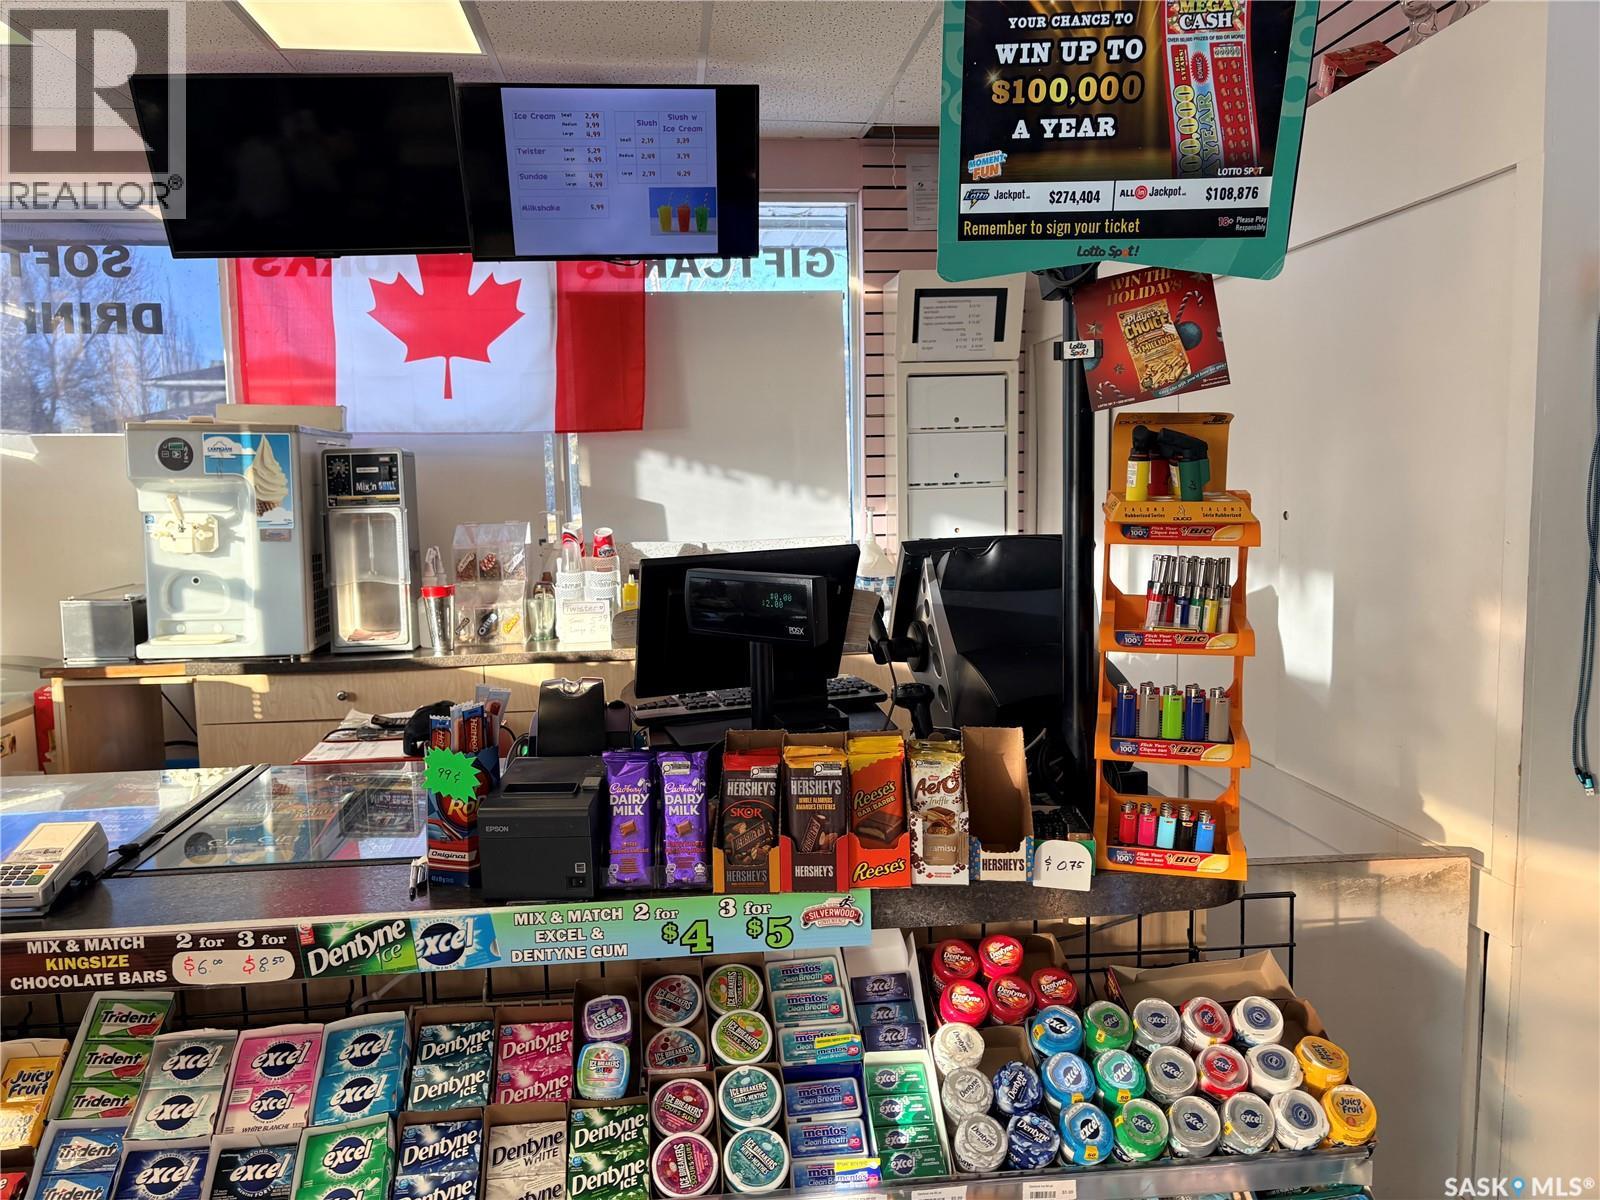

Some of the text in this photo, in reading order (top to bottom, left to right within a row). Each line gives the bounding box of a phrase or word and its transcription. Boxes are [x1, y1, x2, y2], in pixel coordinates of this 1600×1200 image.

[1180, 0, 1233, 12] MEGA
[1008, 12, 1134, 29] YOUR CHANCE TO
[1179, 12, 1233, 29] CASH
[995, 38, 1143, 64] WIN UP TO
[991, 75, 1144, 105] $100,000
[530, 112, 556, 120] Cream
[636, 119, 658, 127] Slush
[667, 113, 688, 121] Slush
[1012, 117, 1116, 140] A YEAR
[517, 147, 546, 155] Twister
[968, 153, 1005, 168] MOMENT
[972, 165, 1001, 180] FUN
[1218, 168, 1242, 176] LOTTO
[994, 188, 1025, 201] Jackpot
[1049, 189, 1101, 206] $274,404
[1119, 186, 1259, 202] ALL Jackpot $108,876
[1236, 216, 1254, 224] Please
[1255, 215, 1267, 224] Play
[964, 218, 1140, 237] Remember to sign your ticket
[1235, 223, 1266, 232] Responsibly
[1077, 245, 1140, 259] Lotto Spot!
[1124, 315, 1171, 340] CHOICE
[1069, 342, 1087, 351] Lotto
[609, 782, 642, 795] Cadbury
[664, 782, 697, 795] Cadbury
[727, 781, 776, 796] HERSHEY'S
[791, 780, 841, 796] HERSHEY'S
[914, 773, 961, 799] Aero
[609, 793, 649, 806] DAIRY
[665, 793, 704, 806] DAIRY
[853, 780, 896, 810] Reese's
[612, 805, 645, 817] MILK
[668, 805, 701, 817] MILK
[730, 807, 763, 819] SKOR
[485, 825, 509, 833] EPSON
[431, 850, 467, 860] Original
[726, 869, 768, 883] HERSHEY'S
[794, 865, 833, 878] HERSHEY'S
[852, 858, 906, 883] Reese's
[633, 902, 679, 921] 2 for
[719, 897, 772, 918] 3 for
[808, 908, 855, 920] SILVERWOOD
[513, 907, 624, 926] MIX & MATCH
[416, 916, 475, 960] excel
[534, 927, 604, 943] EXCEL &
[661, 918, 714, 954] $4
[746, 915, 794, 949] $5
[26, 936, 145, 955] MIX & MATCH
[175, 931, 287, 949] 2 for 3 for
[307, 919, 406, 978] Dentyne
[511, 943, 628, 963] DENTYNE GUM
[988, 943, 1014, 960] Dentyne
[45, 955, 129, 971] KINGSIZE
[781, 964, 822, 976] mentos
[10, 970, 167, 990] CHOCOLATE BARS
[799, 972, 823, 982] Breath
[787, 994, 828, 1004] mentos
[805, 1002, 829, 1012] Breath
[101, 1009, 158, 1024] Trident
[593, 1012, 607, 1024] ICE
[594, 1012, 624, 1030] CUBES
[421, 1028, 490, 1061] Dentyne
[466, 1043, 484, 1056] ICE
[665, 1044, 695, 1058] BREAKERS
[161, 1044, 224, 1073] excel
[251, 1040, 312, 1070] excel
[597, 1060, 620, 1068] BREAKERS
[10, 1069, 54, 1085] Juicy
[8, 1082, 49, 1099] Fruit
[412, 1069, 485, 1104] Dentyne
[459, 1085, 478, 1098] ICE
[500, 1074, 569, 1104] Dentyne
[797, 1085, 841, 1097] mentos
[545, 1090, 562, 1101] ICE
[817, 1094, 842, 1104] Breath
[1338, 1097, 1361, 1108] Juicy
[146, 1094, 208, 1122] excel
[249, 1093, 295, 1115] excel
[1240, 1110, 1263, 1124] excel
[262, 1124, 290, 1132] BLANCHE
[1017, 1120, 1051, 1143] Dentyne
[1080, 1117, 1101, 1141] excel
[58, 1143, 117, 1159] Trident
[402, 1129, 478, 1168] Dentyne
[450, 1147, 469, 1161] ICE
[523, 1149, 560, 1168] WHITE
[135, 1156, 200, 1185] excel
[808, 1167, 834, 1178] men
